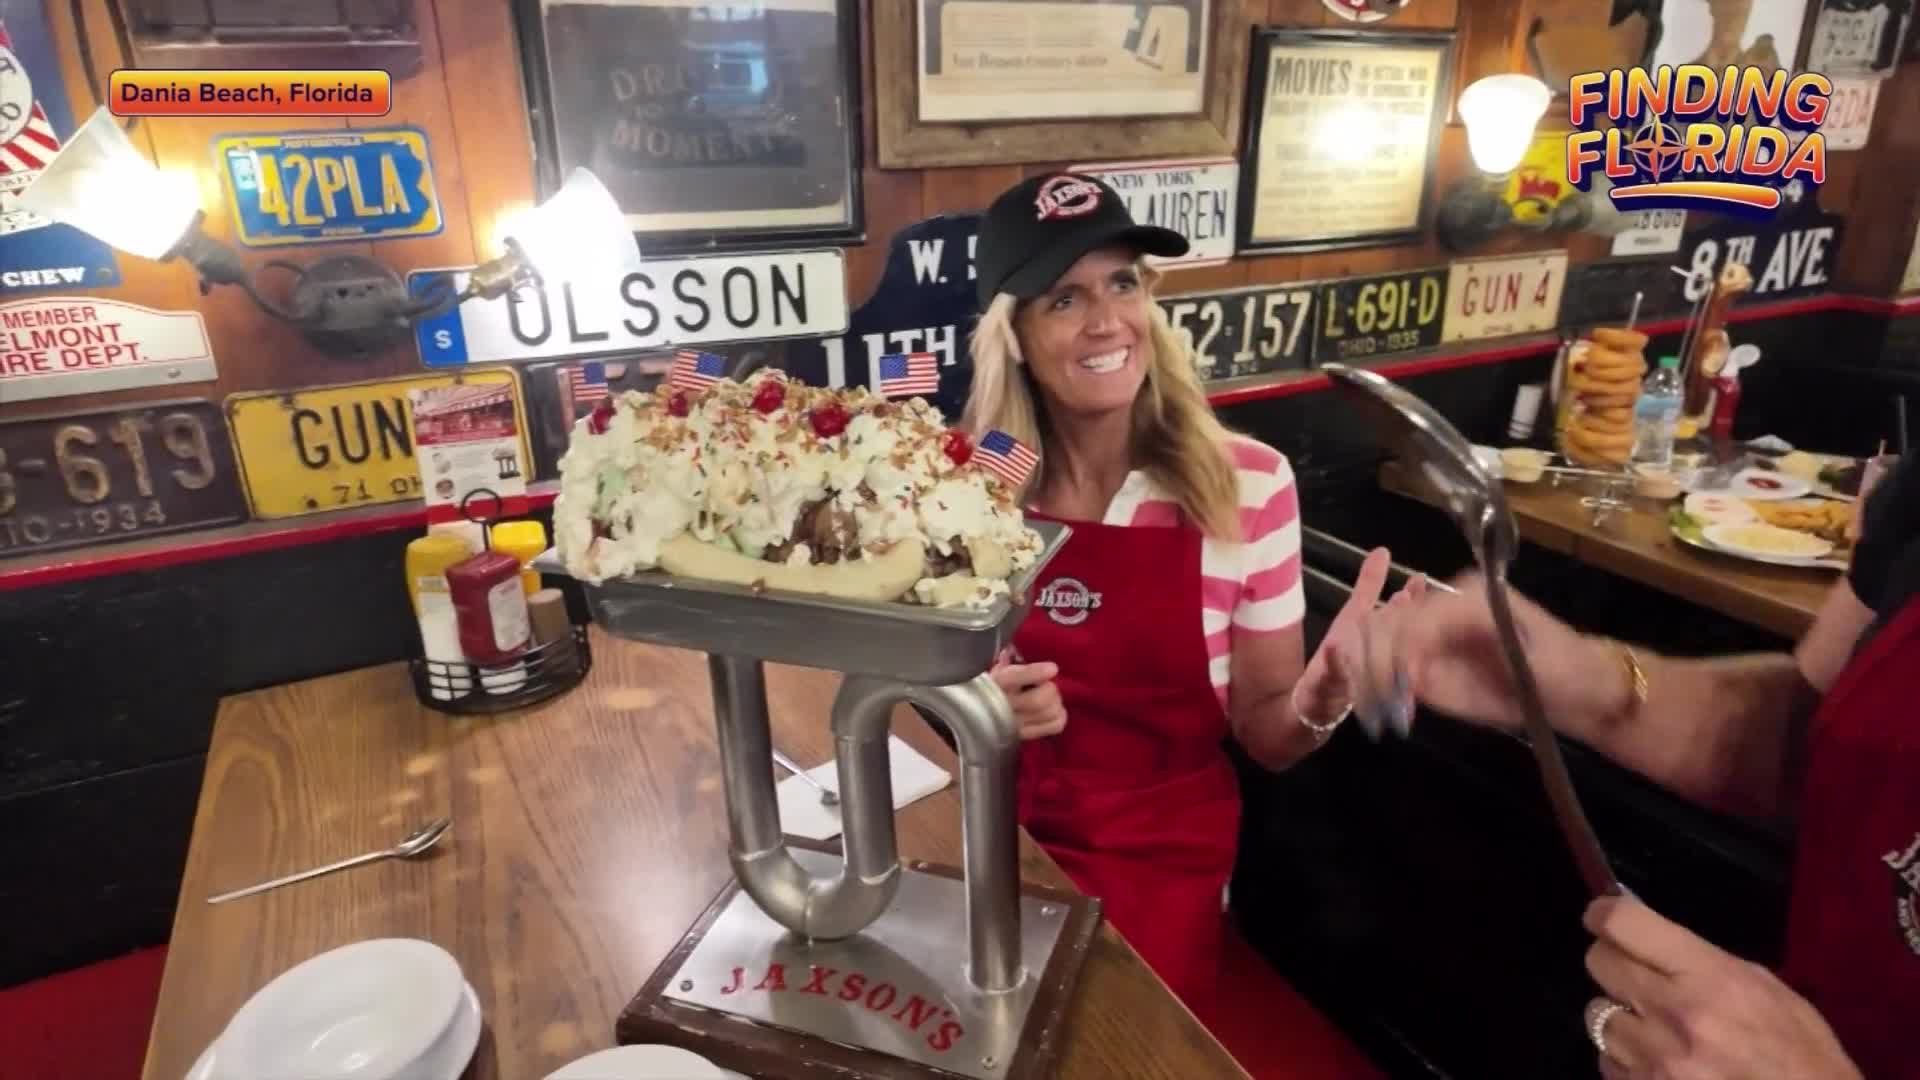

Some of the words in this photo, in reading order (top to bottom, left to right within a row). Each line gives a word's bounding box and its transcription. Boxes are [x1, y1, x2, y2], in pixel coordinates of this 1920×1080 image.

[1271, 56, 1353, 96] MOVIES
[258, 153, 412, 226] 42PLA
[1155, 172, 1195, 188] YORK
[2, 266, 86, 287] CHEW
[907, 238, 949, 285] W.
[1755, 227, 1834, 294] AVE.
[1462, 271, 1523, 317] GUN
[1533, 268, 1550, 308] 4
[3, 306, 98, 329] MEMBER
[61, 342, 149, 368] DEPT.
[434, 329, 453, 350] S
[290, 396, 414, 470] GUN
[332, 480, 375, 505] 71
[1034, 588, 1103, 609] JAXSON'S
[720, 962, 965, 1053] JAXSON'S
